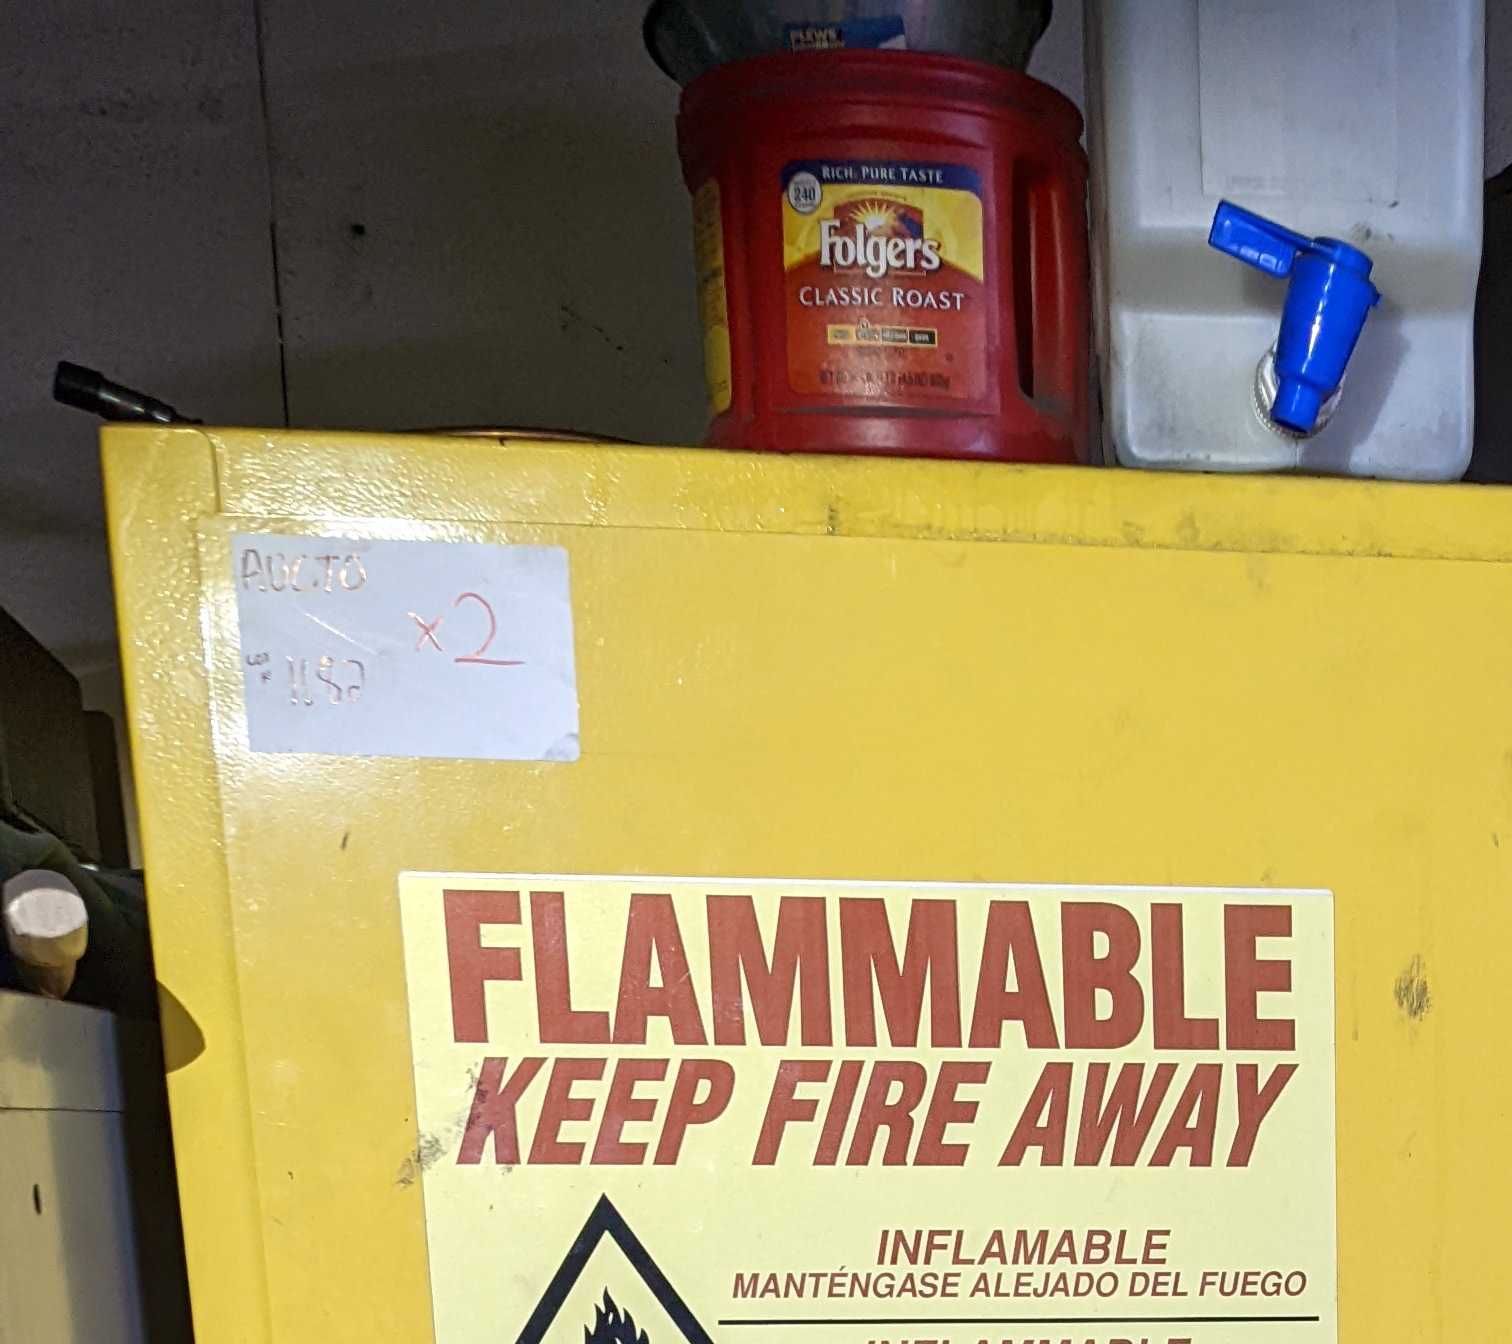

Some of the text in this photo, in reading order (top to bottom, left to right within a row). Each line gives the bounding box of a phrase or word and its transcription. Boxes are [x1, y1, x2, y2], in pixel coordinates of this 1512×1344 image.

[862, 165, 896, 181] PURE
[899, 167, 944, 184] TASTE
[819, 219, 941, 279] Folgers
[800, 286, 965, 311] CLASSIC ROAST
[442, 889, 1297, 1052] FLAMMABLE
[455, 1057, 1299, 1168] KEEP FIRE AWAY
[876, 1229, 1171, 1266] INFLAMABLE
[732, 1265, 1309, 1299] MANTÉNGASE ALEJADO DEL FUEGO
